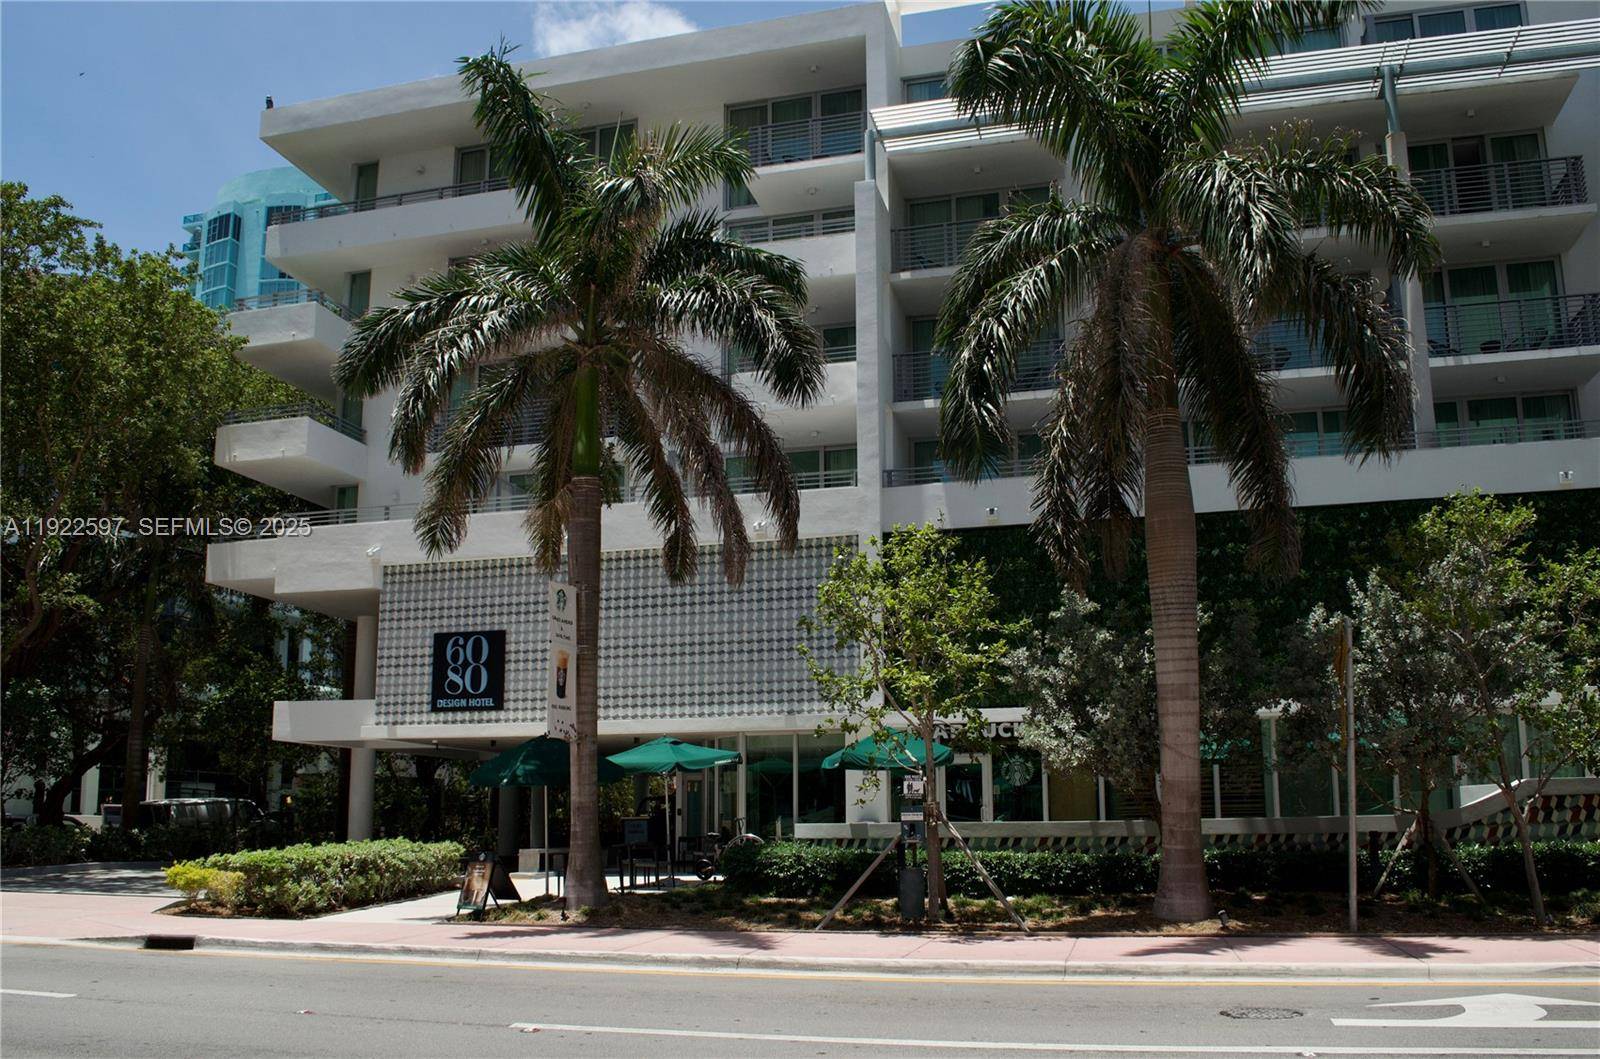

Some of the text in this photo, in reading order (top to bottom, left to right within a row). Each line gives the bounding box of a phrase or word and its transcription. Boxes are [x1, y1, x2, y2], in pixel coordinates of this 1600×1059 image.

[446, 634, 489, 666] 60
[444, 663, 488, 695] 80
[436, 697, 495, 708] DESIGN HOTEL
